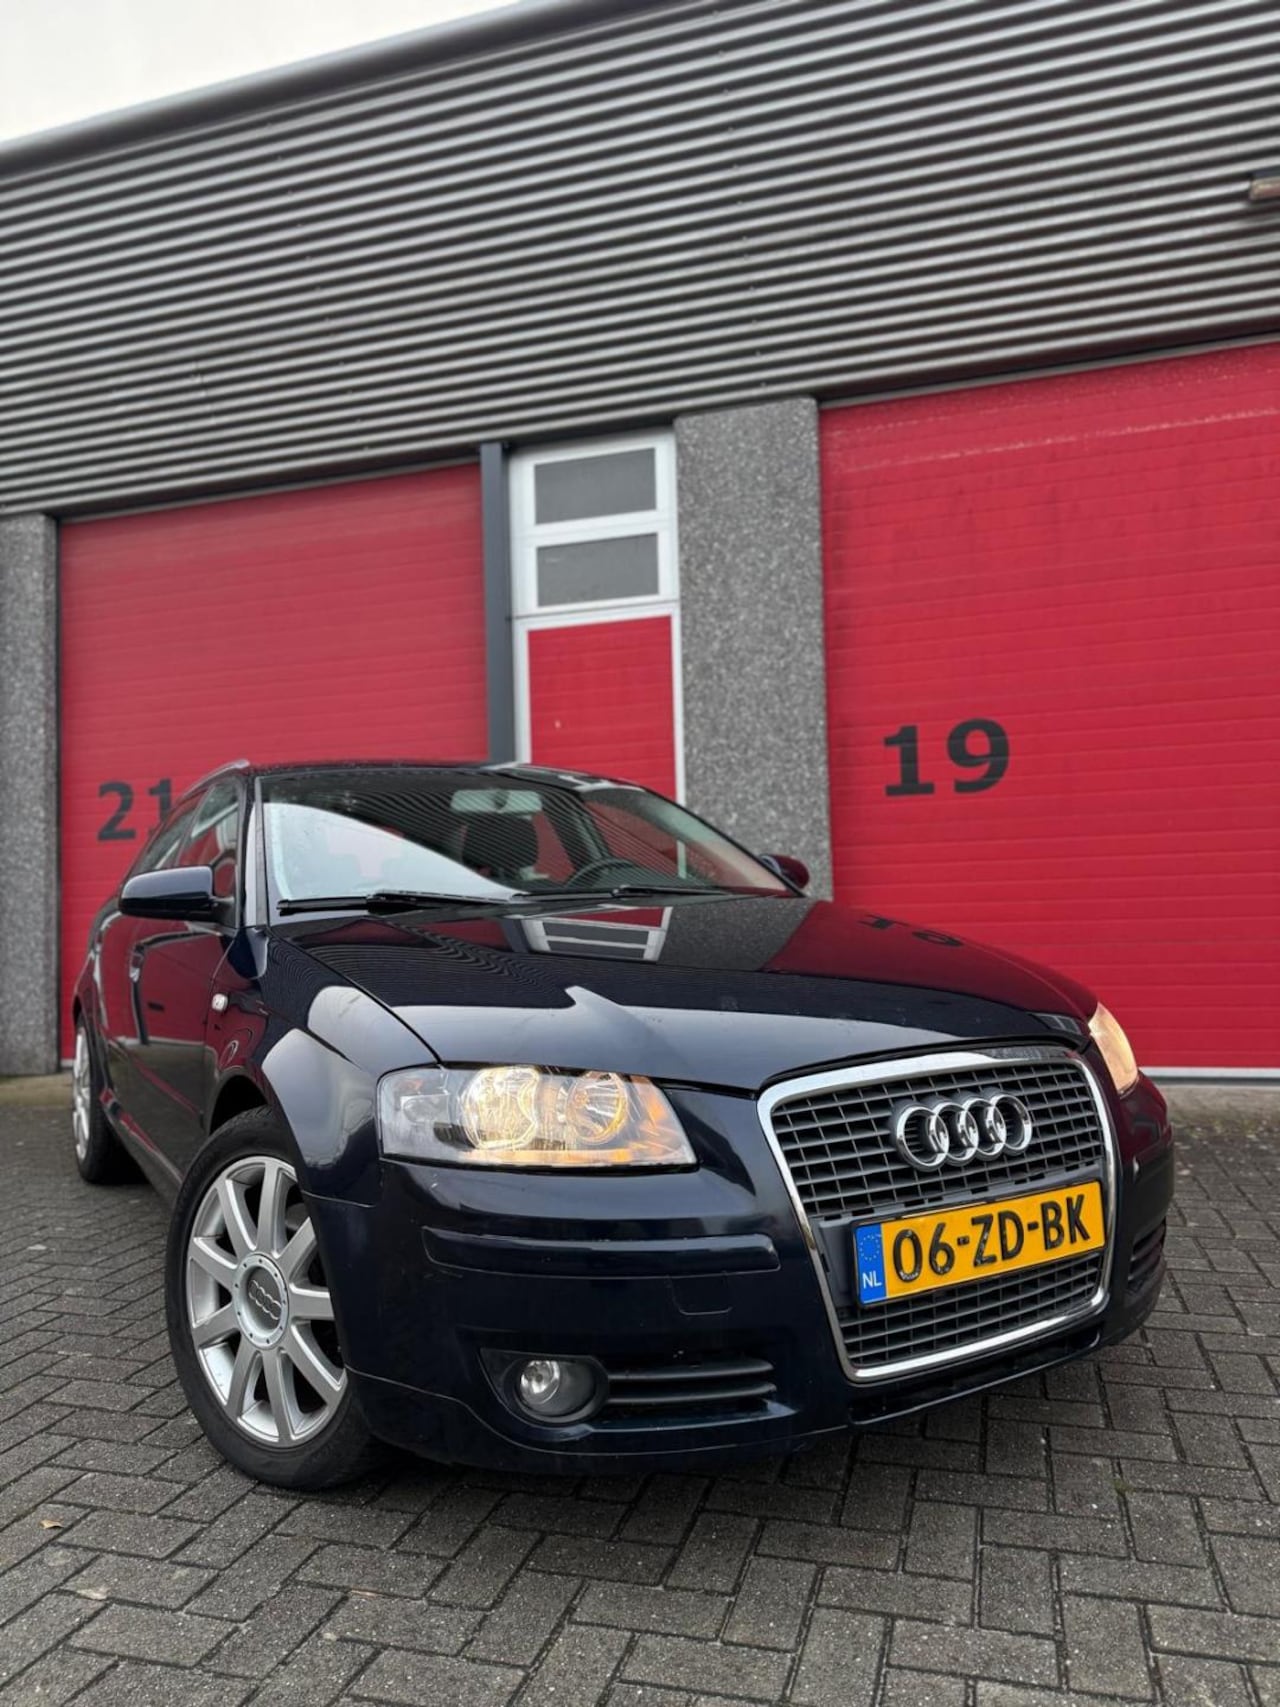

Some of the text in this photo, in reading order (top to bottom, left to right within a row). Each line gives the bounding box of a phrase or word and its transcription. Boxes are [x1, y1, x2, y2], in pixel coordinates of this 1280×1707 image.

[884, 718, 1010, 796] 19
[97, 778, 171, 841] 21
[893, 1194, 1090, 1282] 06-ZD-BK
[863, 1269, 882, 1288] NL
